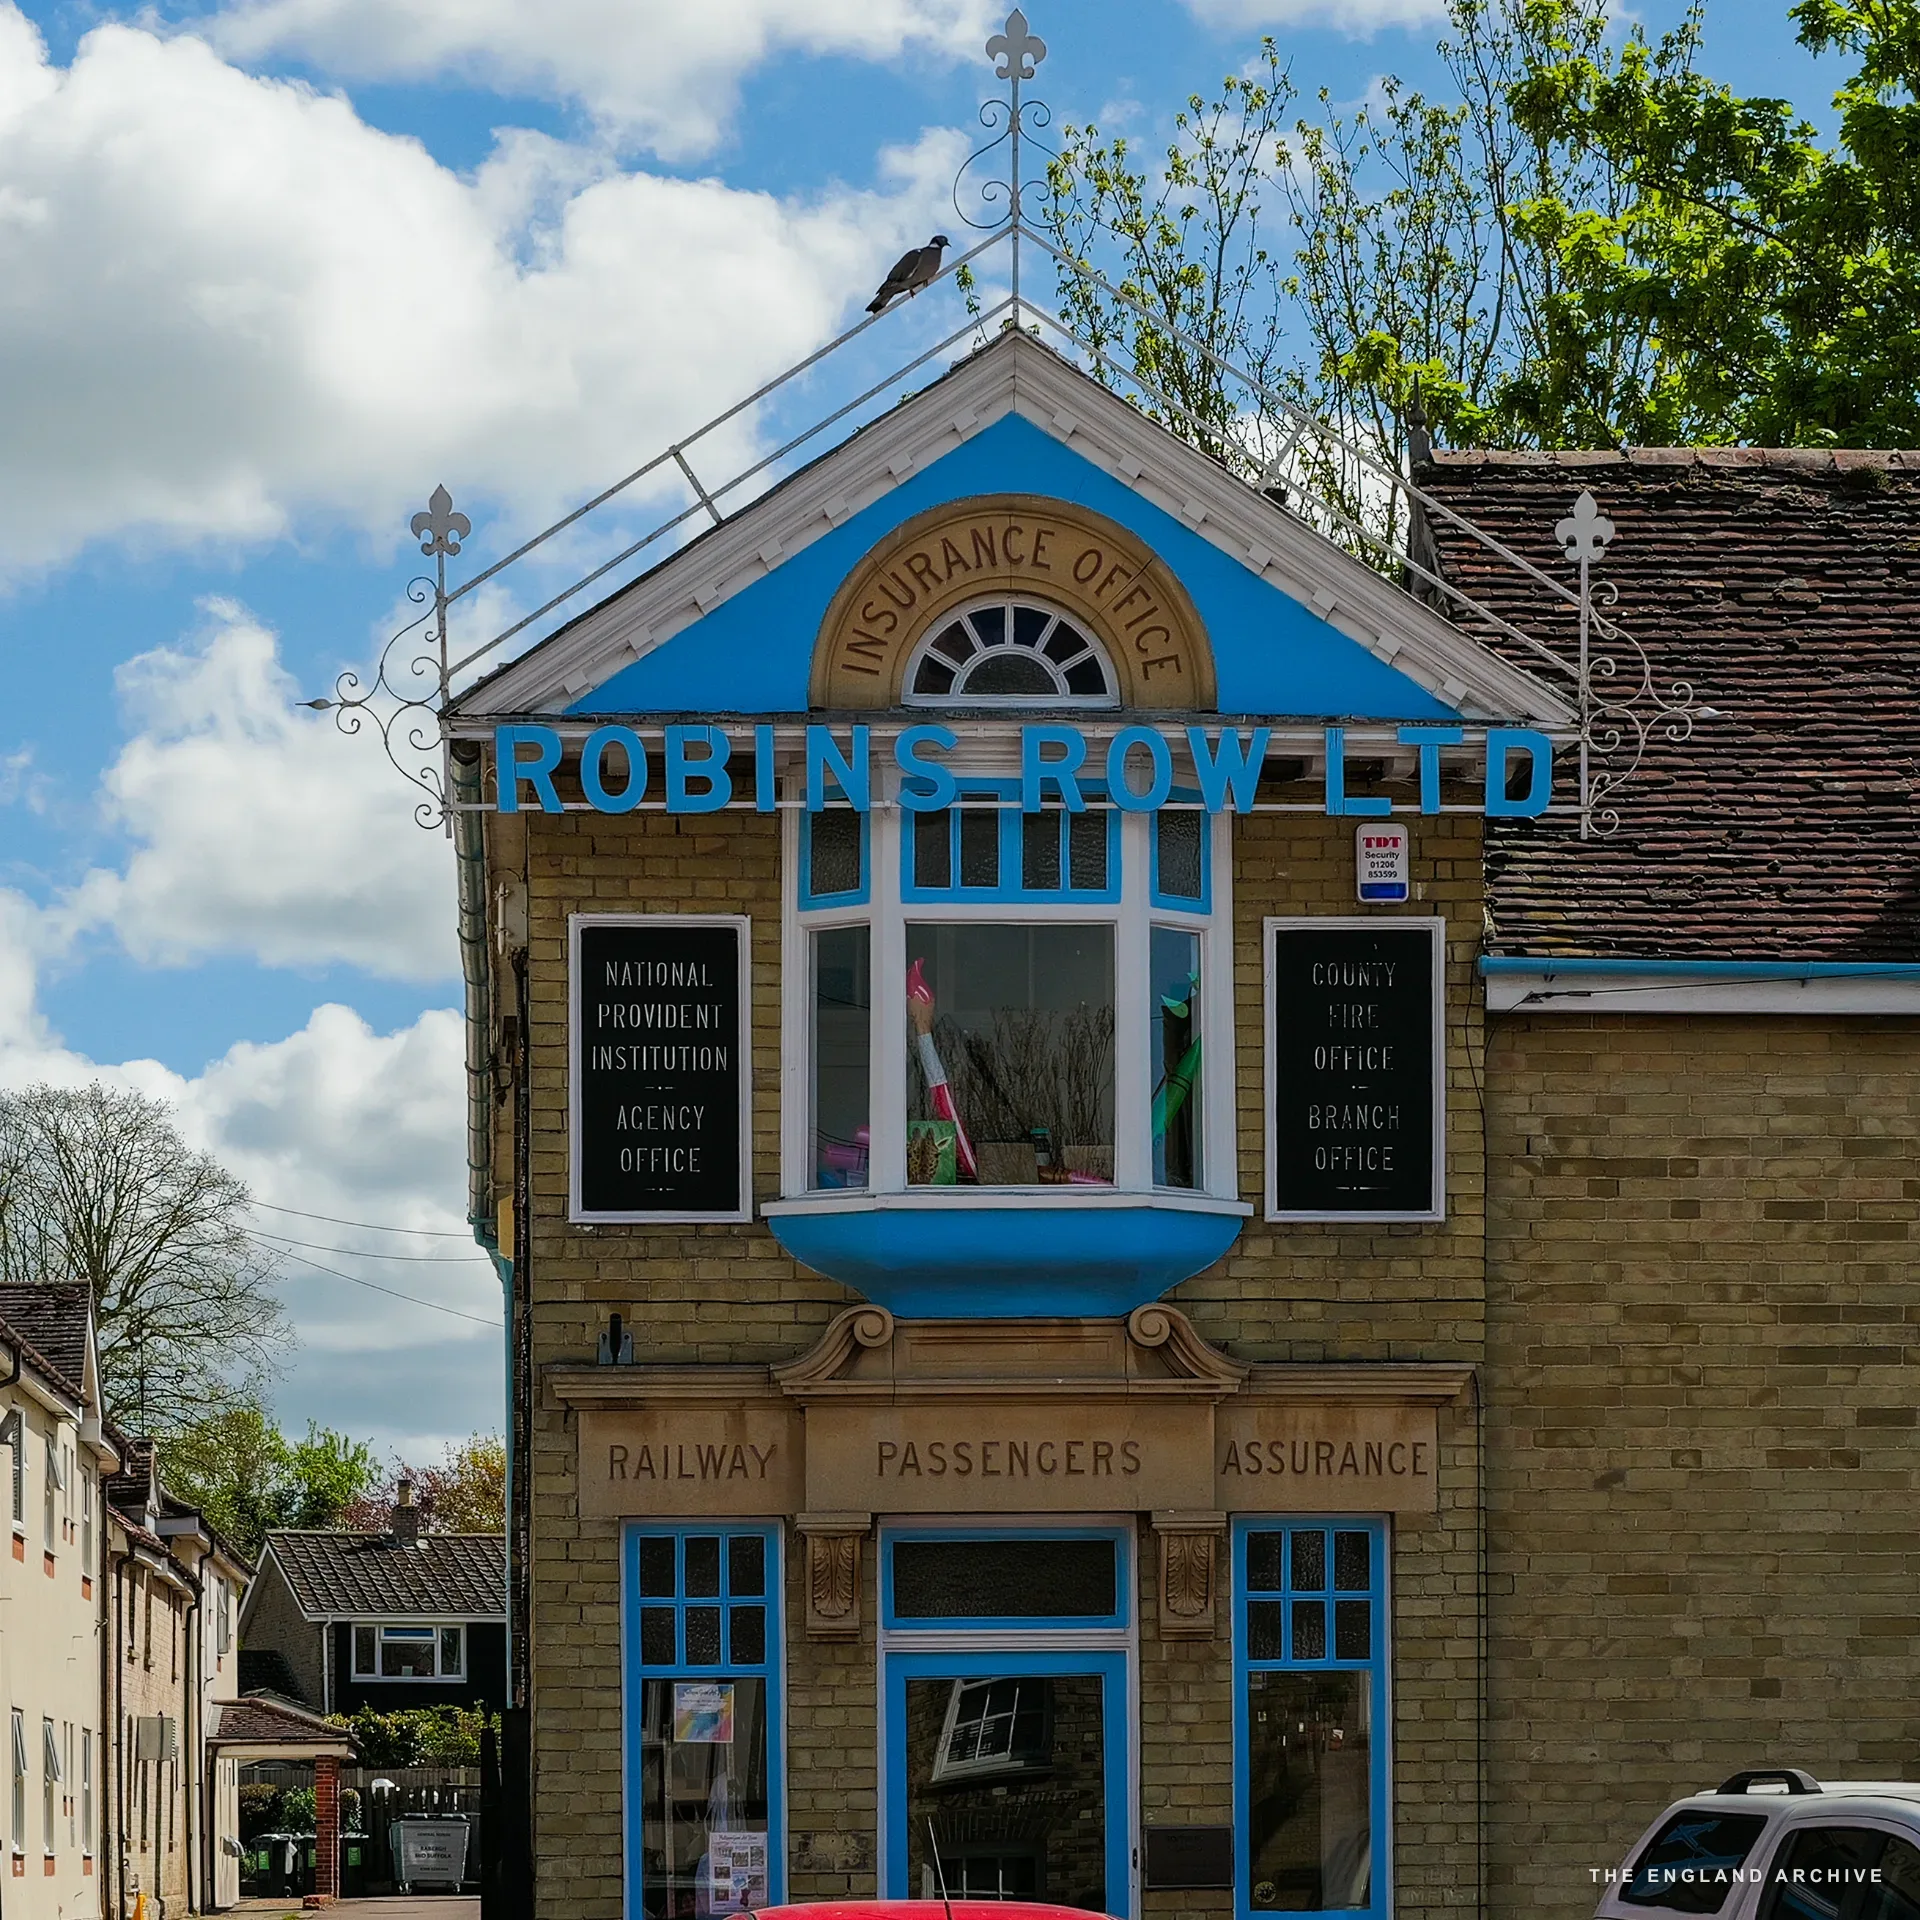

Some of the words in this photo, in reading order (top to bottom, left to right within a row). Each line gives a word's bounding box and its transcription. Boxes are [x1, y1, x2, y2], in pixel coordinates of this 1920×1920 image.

[841, 524, 1055, 677] INSURANCE
[1072, 547, 1183, 682] OFFICE
[496, 724, 958, 814] ROBINS
[1022, 725, 1270, 813] ROW
[1325, 725, 1554, 819] LTD
[1362, 837, 1402, 848] TDT
[1365, 851, 1400, 860] Security
[1370, 861, 1395, 869] 01206
[606, 961, 713, 987] NATIONAL
[1313, 962, 1396, 987] COUNTY
[598, 1003, 722, 1029] PROVIDENT
[1328, 1004, 1379, 1029] FIRE
[591, 1046, 728, 1071] INSTITUTION
[1313, 1046, 1394, 1071] OFFICE
[616, 1105, 705, 1130] AGENCY
[1308, 1104, 1400, 1130] BRANCH
[620, 1147, 701, 1173] OFFICE
[1314, 1146, 1394, 1171] OFFICE
[608, 1443, 777, 1480] RAILWAY
[877, 1440, 1142, 1477] PASSENGERS
[1220, 1439, 1429, 1477] ASSURANCE
